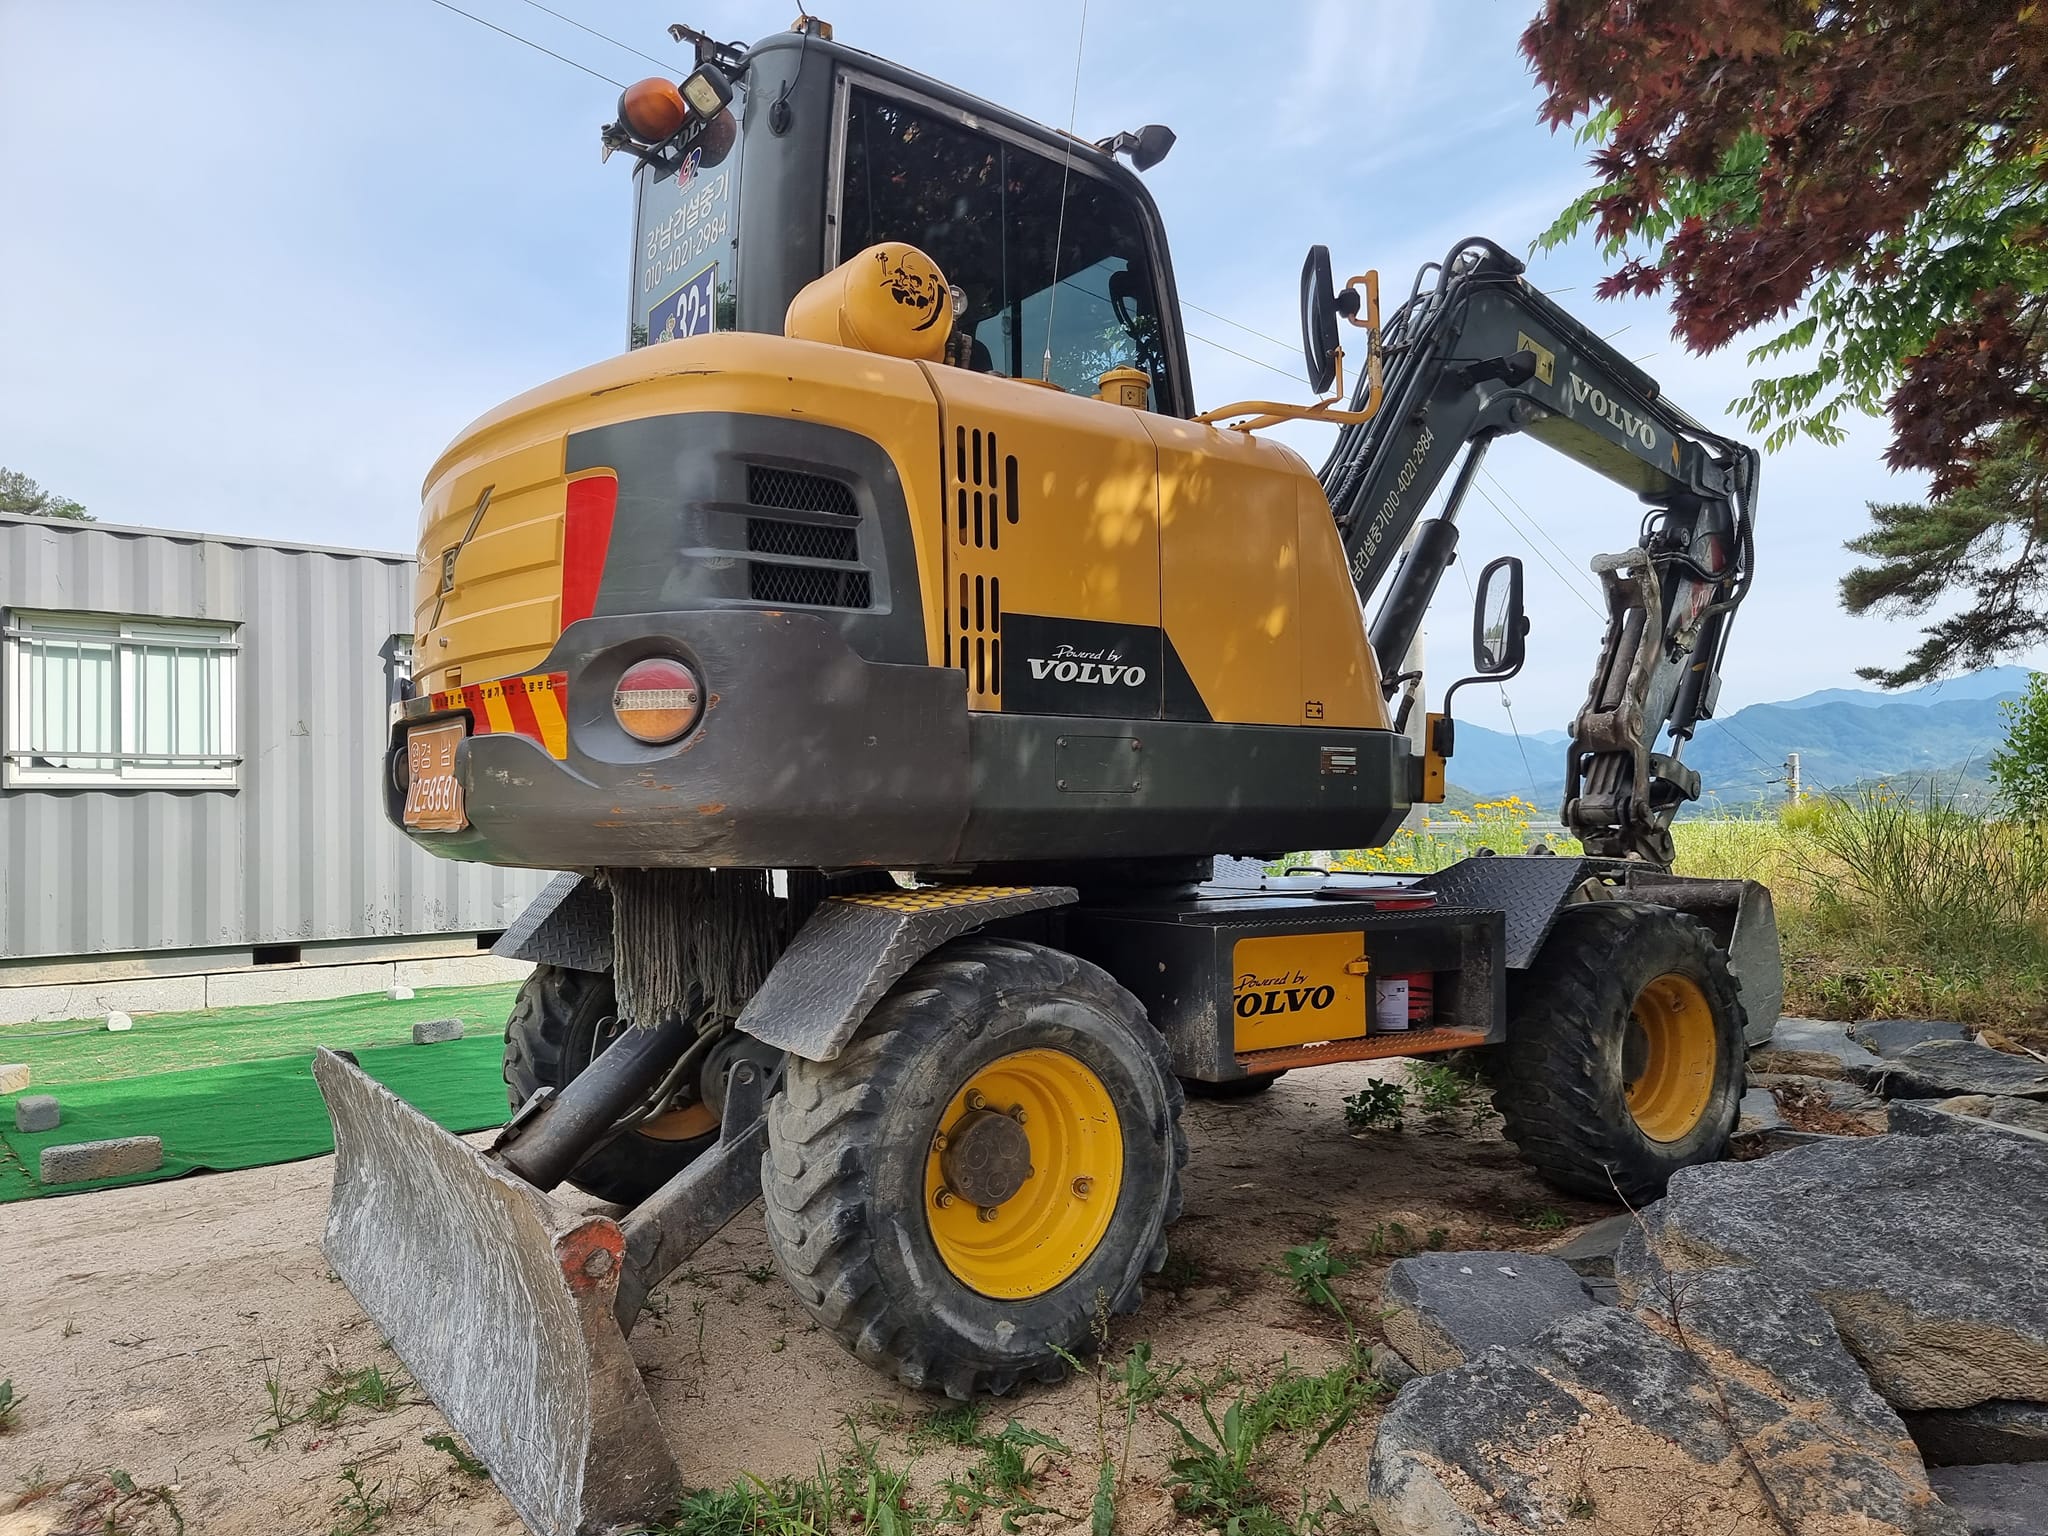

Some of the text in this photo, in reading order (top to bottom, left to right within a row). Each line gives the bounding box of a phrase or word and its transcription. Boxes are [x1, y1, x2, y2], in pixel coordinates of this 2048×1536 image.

[647, 169, 730, 260] 강남건설중기
[644, 211, 728, 293] 010-4021-2984
[1569, 371, 1656, 450] VOLVO
[1052, 644, 1122, 662] Powered by
[1027, 658, 1146, 687] VOLVO
[1234, 969, 1309, 991] Powered by
[1234, 985, 1335, 1018] OLVO
